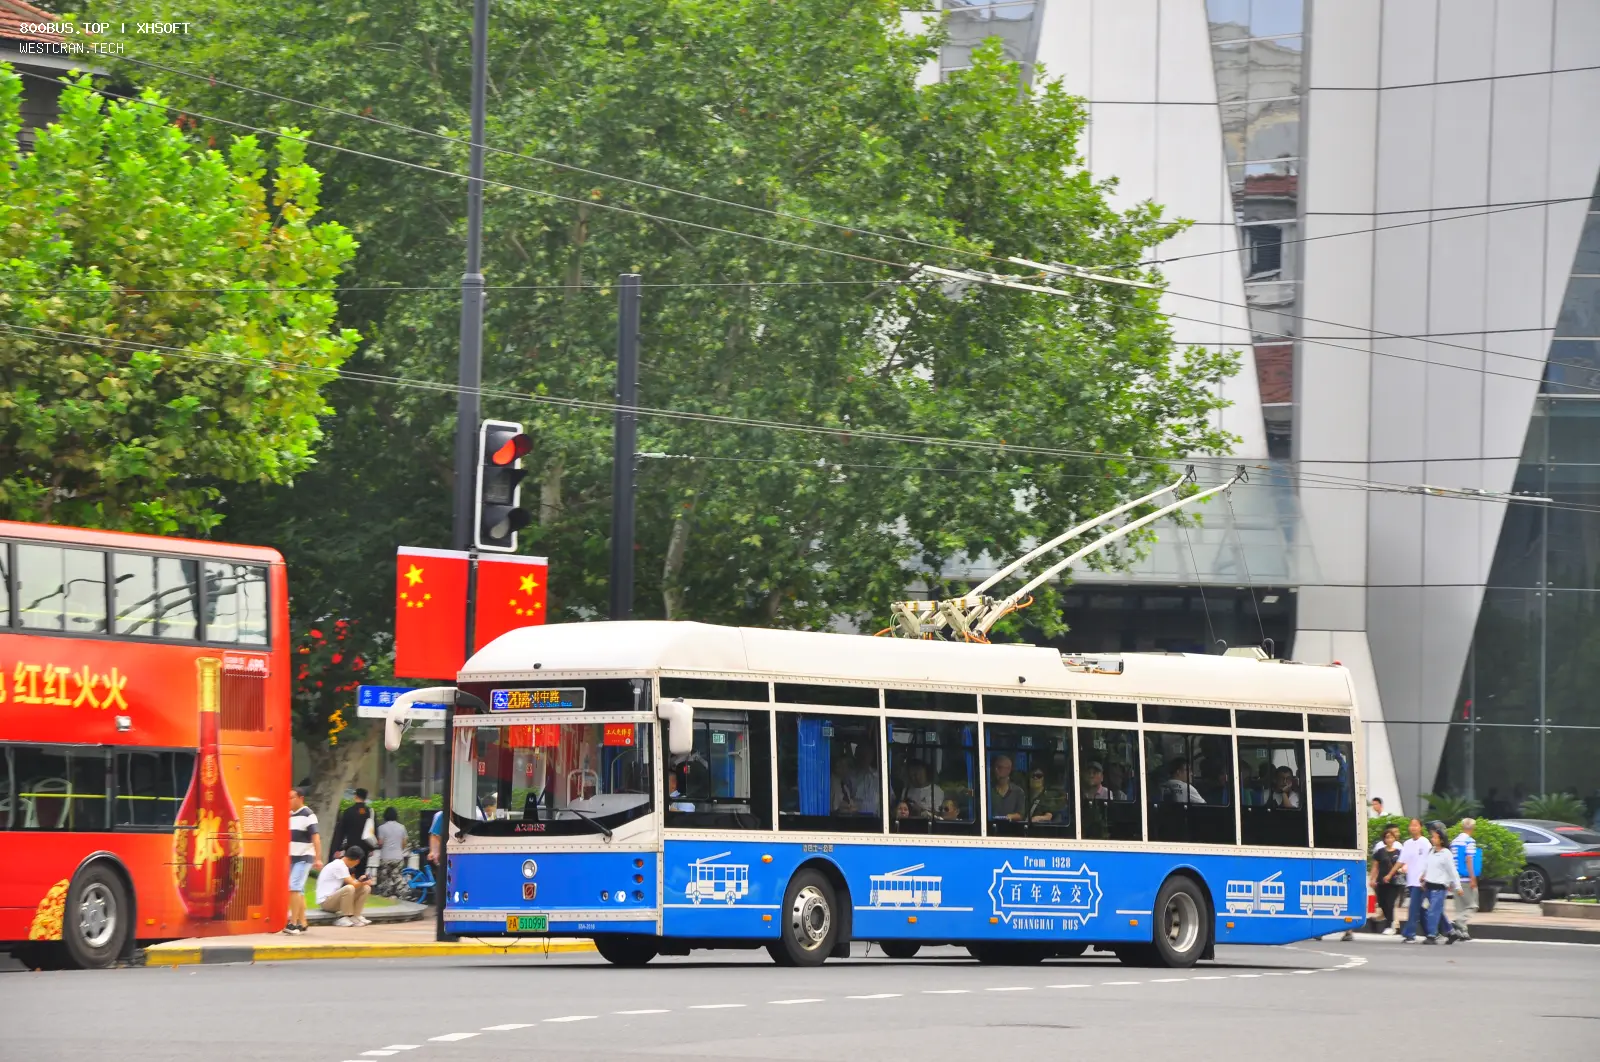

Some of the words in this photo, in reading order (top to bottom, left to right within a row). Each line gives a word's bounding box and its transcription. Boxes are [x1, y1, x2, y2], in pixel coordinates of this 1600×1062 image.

[1023, 855, 1046, 868] From
[1052, 856, 1071, 868] 1928
[1010, 883, 1082, 904] 百年公交
[1012, 918, 1054, 931] SHANGHAI
[1062, 919, 1079, 931] BUS
